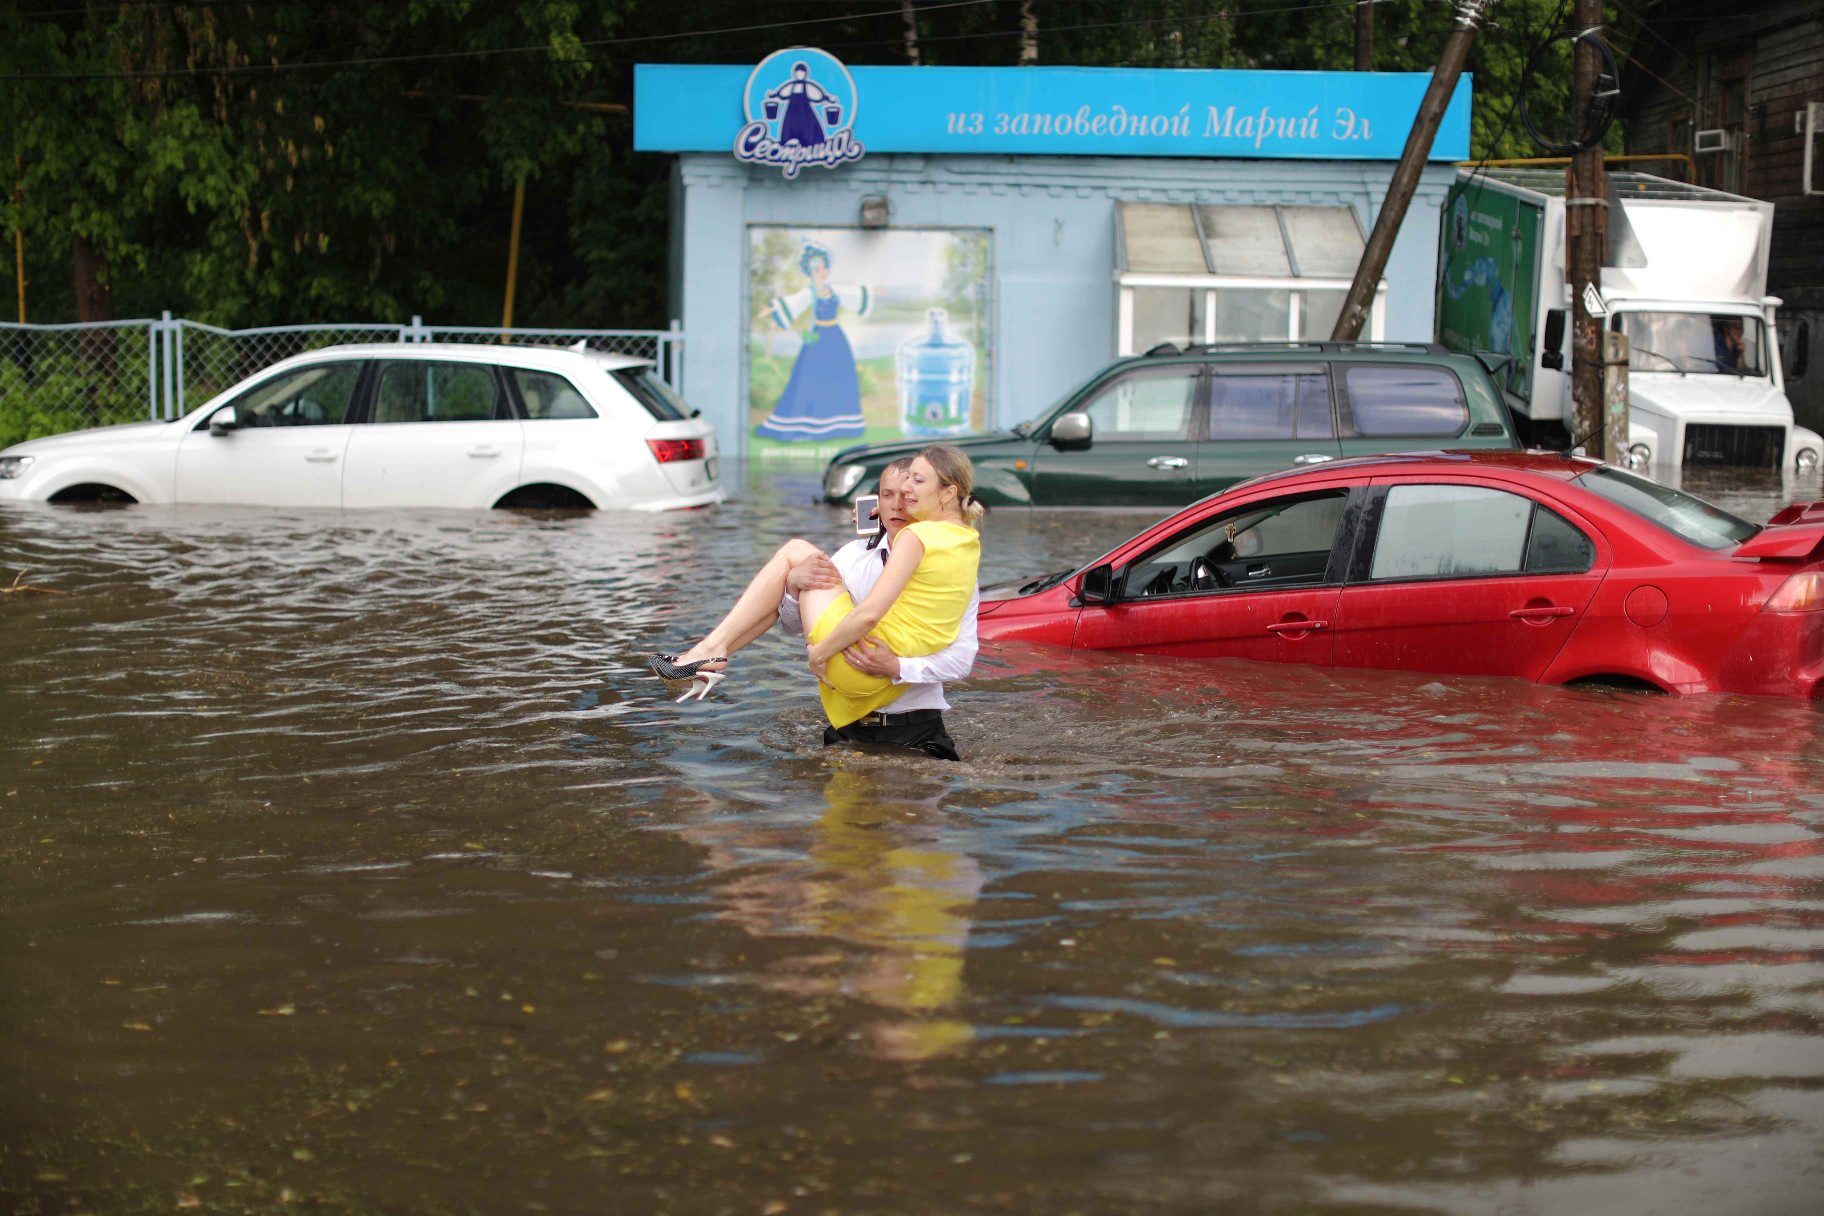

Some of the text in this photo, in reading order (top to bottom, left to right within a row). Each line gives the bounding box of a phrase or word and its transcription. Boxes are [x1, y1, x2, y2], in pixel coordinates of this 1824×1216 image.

[735, 122, 864, 178] Сестрица
[946, 102, 1373, 149] из заповедной Марий Эл
